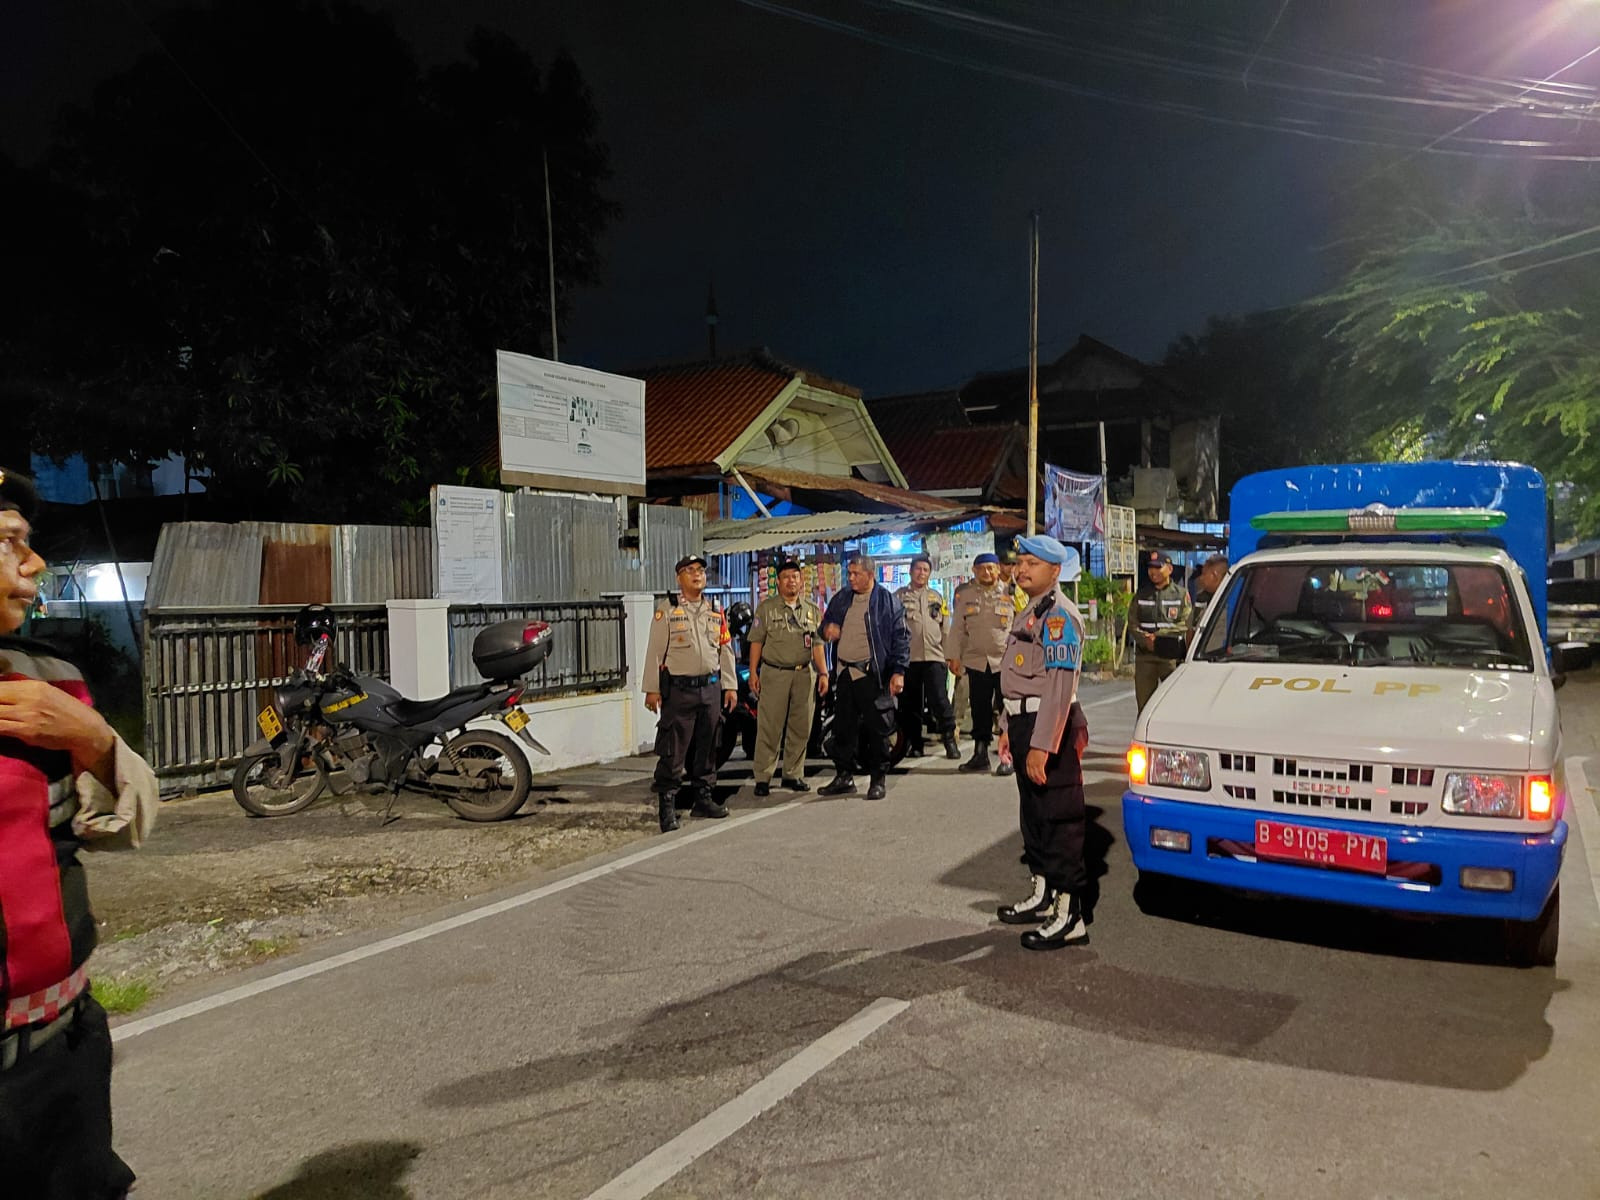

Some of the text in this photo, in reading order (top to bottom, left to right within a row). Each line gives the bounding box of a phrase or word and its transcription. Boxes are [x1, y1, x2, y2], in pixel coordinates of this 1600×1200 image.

[1247, 677, 1442, 697] POL PP
[1292, 780, 1351, 796] ISUZU
[1258, 822, 1270, 844] B
[1283, 826, 1329, 852] 9105
[1346, 835, 1382, 862] PTA
